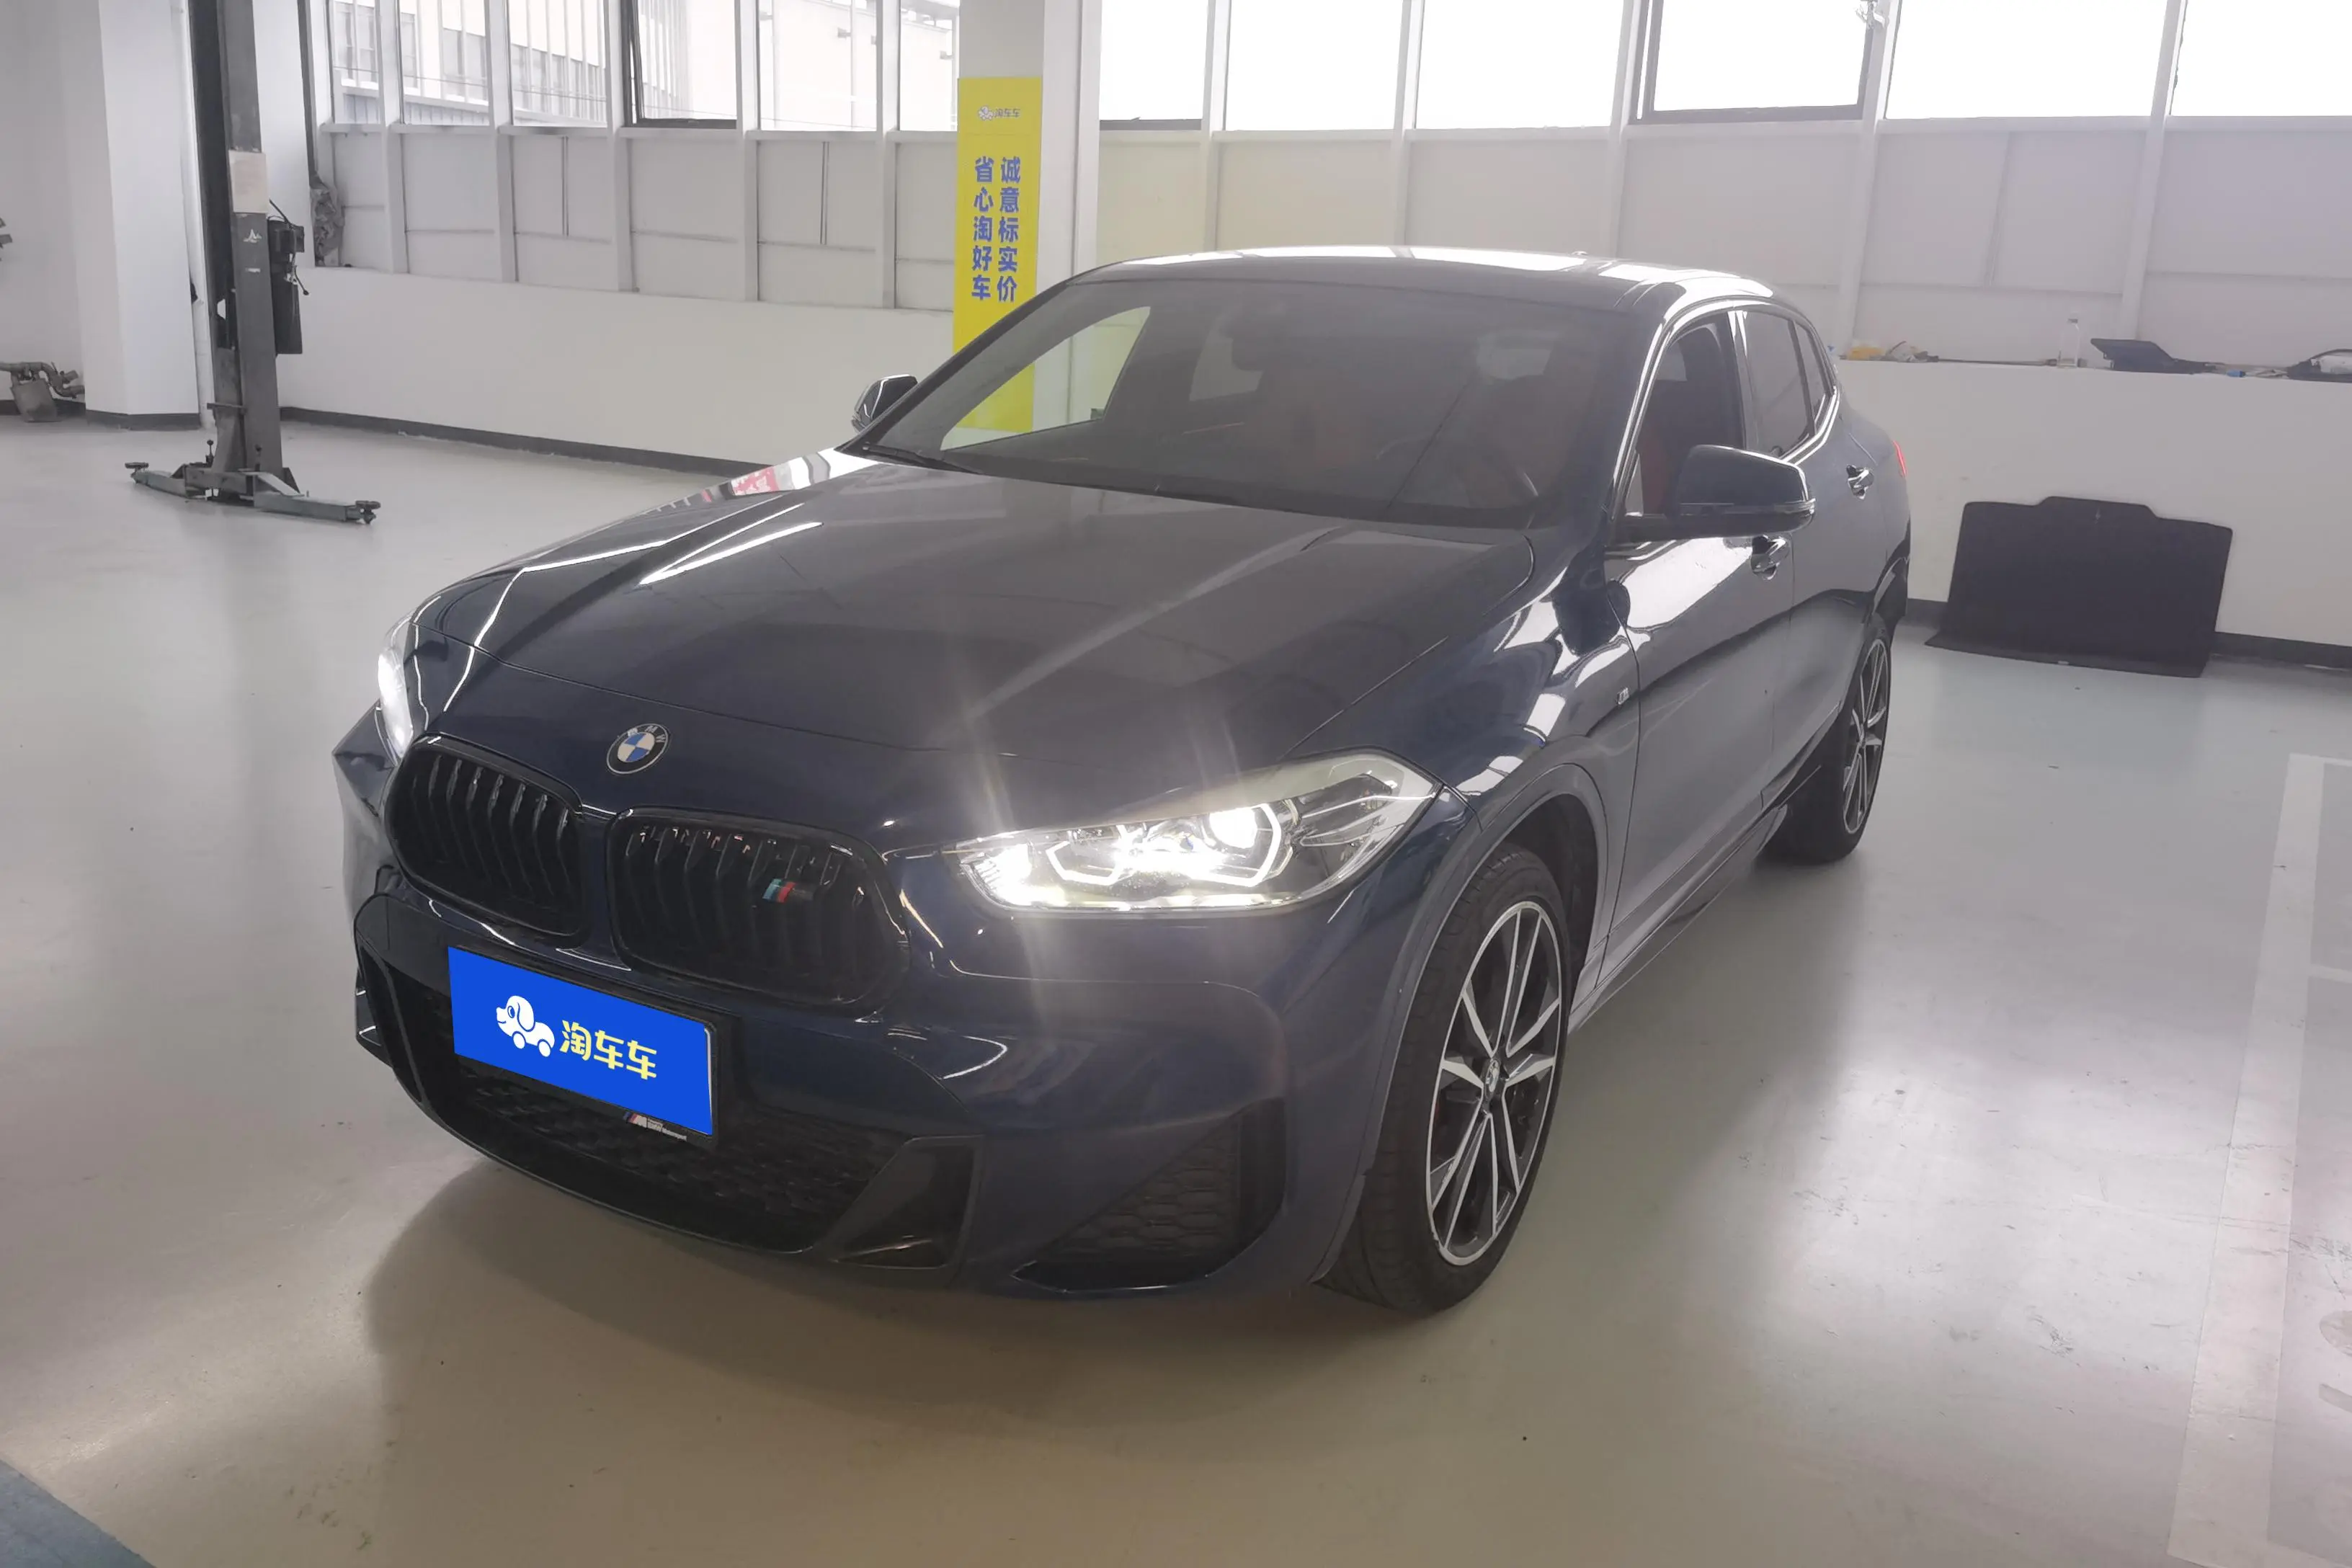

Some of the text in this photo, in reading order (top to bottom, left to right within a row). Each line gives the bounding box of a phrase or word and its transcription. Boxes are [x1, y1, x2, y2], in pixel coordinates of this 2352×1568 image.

[971, 156, 994, 300] 省心淘好车
[997, 156, 1021, 302] 诚意标实价
